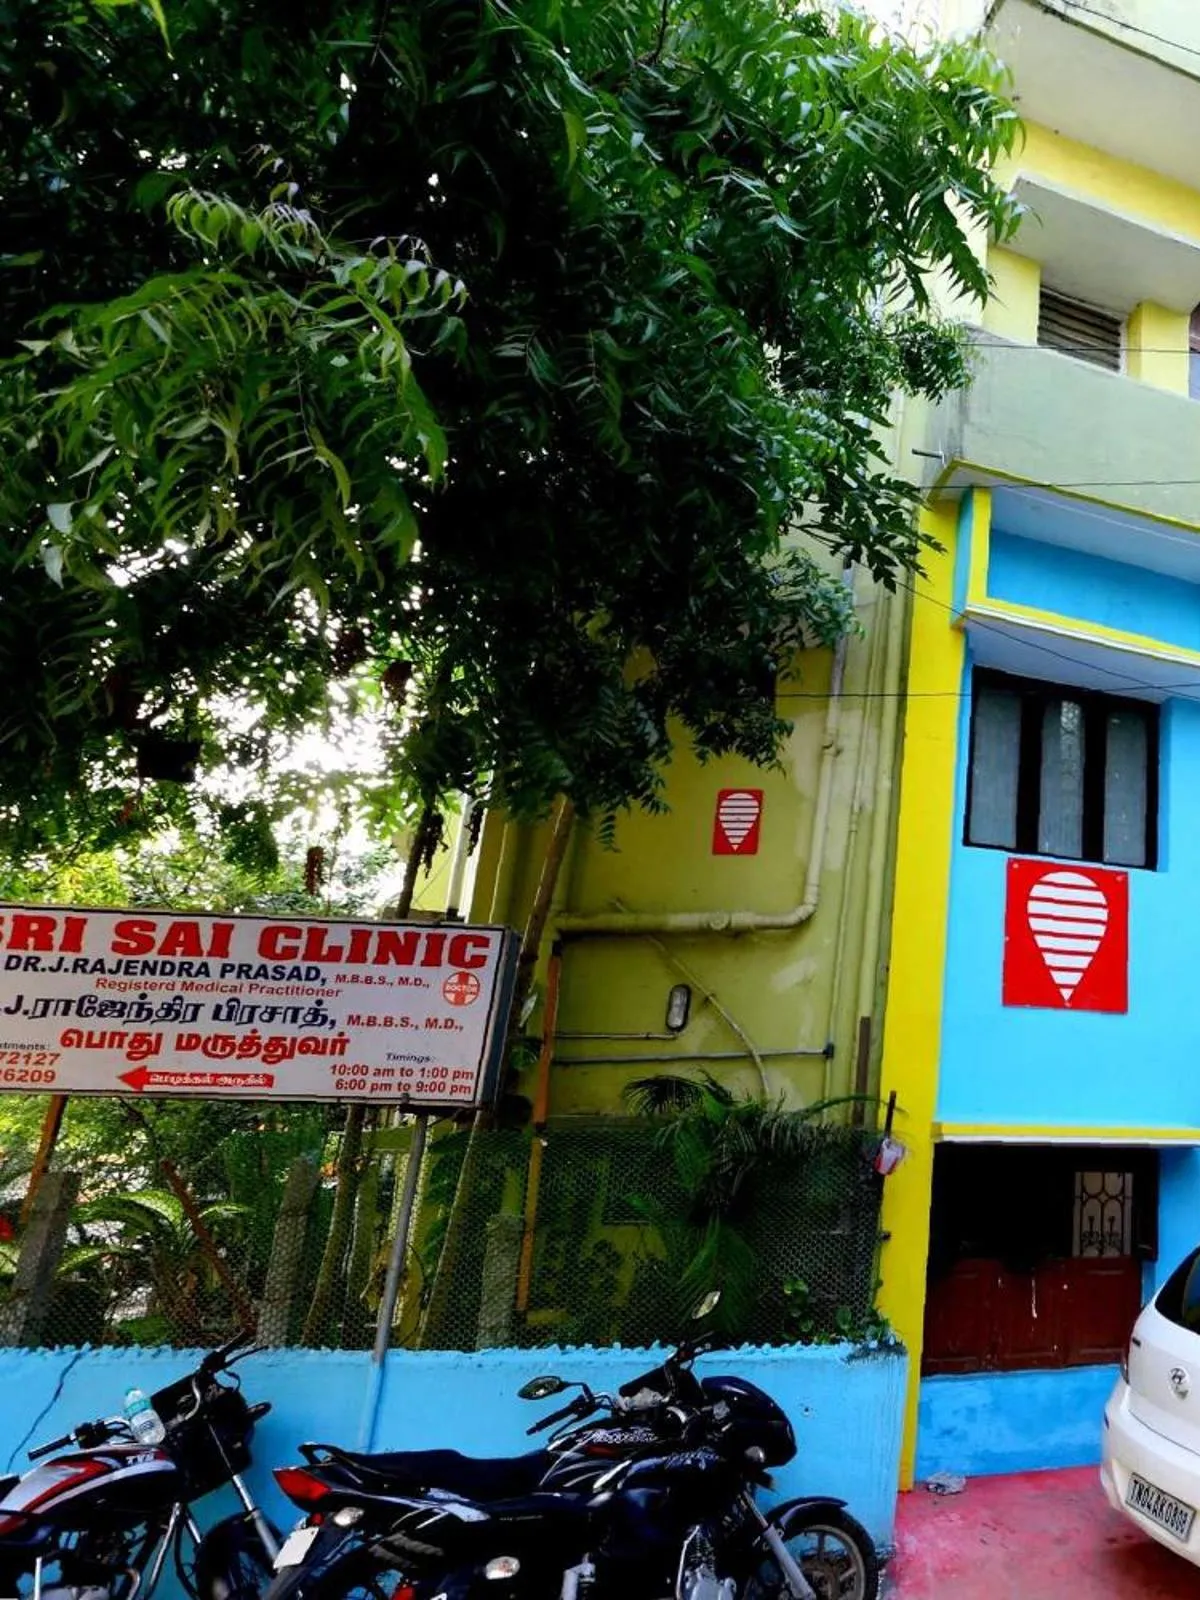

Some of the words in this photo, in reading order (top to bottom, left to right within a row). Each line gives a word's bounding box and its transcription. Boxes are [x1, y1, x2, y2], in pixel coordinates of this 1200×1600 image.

[0, 915, 88, 952] RI
[111, 919, 235, 958] SAI
[257, 925, 490, 969] CLINIC
[4, 954, 211, 978] DR.J.RAJENDRA
[220, 962, 327, 986] PRASAD,
[95, 977, 176, 993] Registerd
[180, 980, 243, 994] Medical
[248, 982, 343, 998] Practitioner
[59, 1027, 164, 1062] பொது
[174, 1028, 350, 1066] மருத்துவர்
[0, 1068, 56, 1084] 6209
[331, 1064, 369, 1077] 10:00
[373, 1066, 395, 1078] am
[401, 1066, 414, 1079] to
[419, 1067, 449, 1079] 1:00
[452, 1069, 475, 1081] pm
[335, 1079, 366, 1091] 6:00
[370, 1081, 392, 1093] pm
[398, 1080, 412, 1092] to
[415, 1081, 446, 1093] 9:00
[449, 1083, 472, 1095] pm
